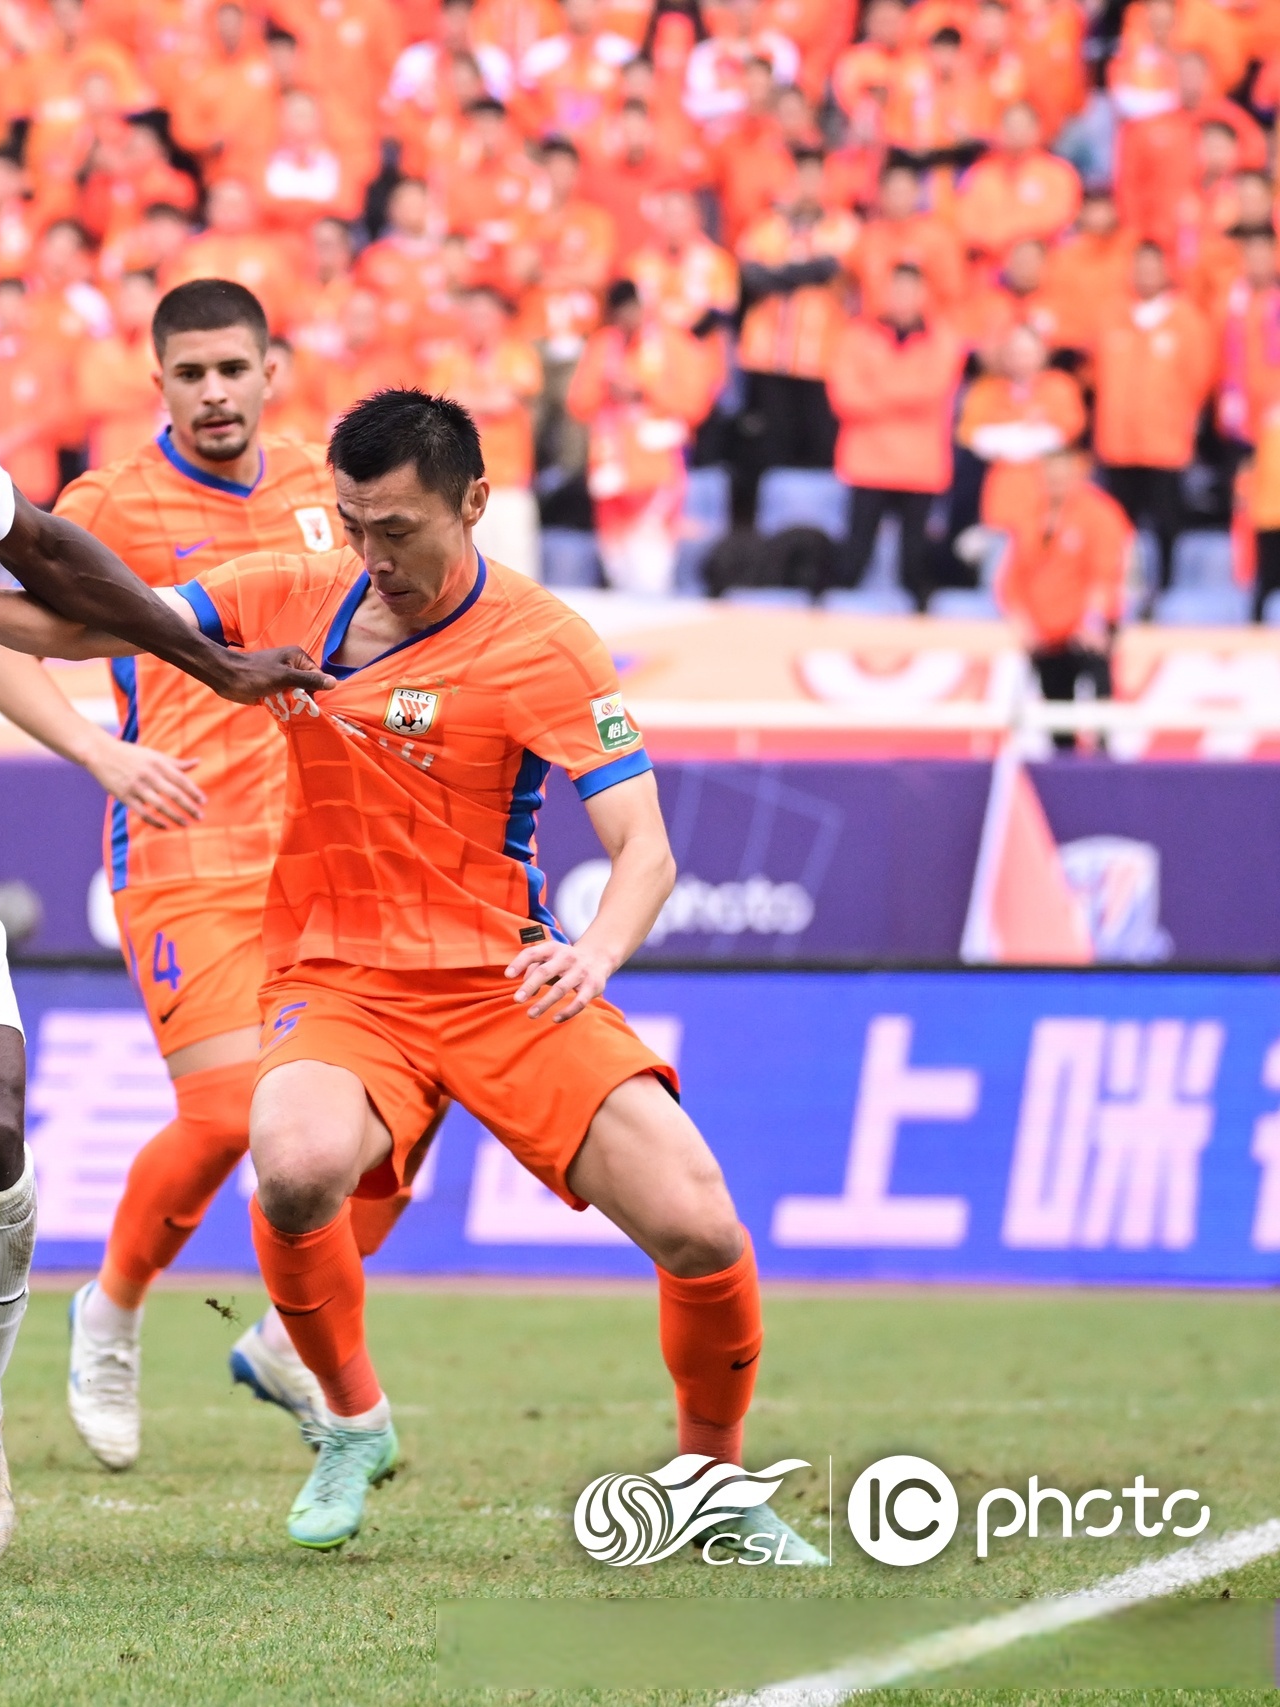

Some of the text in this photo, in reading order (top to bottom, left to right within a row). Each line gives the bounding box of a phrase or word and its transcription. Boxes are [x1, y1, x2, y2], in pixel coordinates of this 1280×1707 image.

[397, 689, 433, 703] TSFC
[154, 932, 182, 990] 4
[772, 1014, 1280, 1250] 上咪
